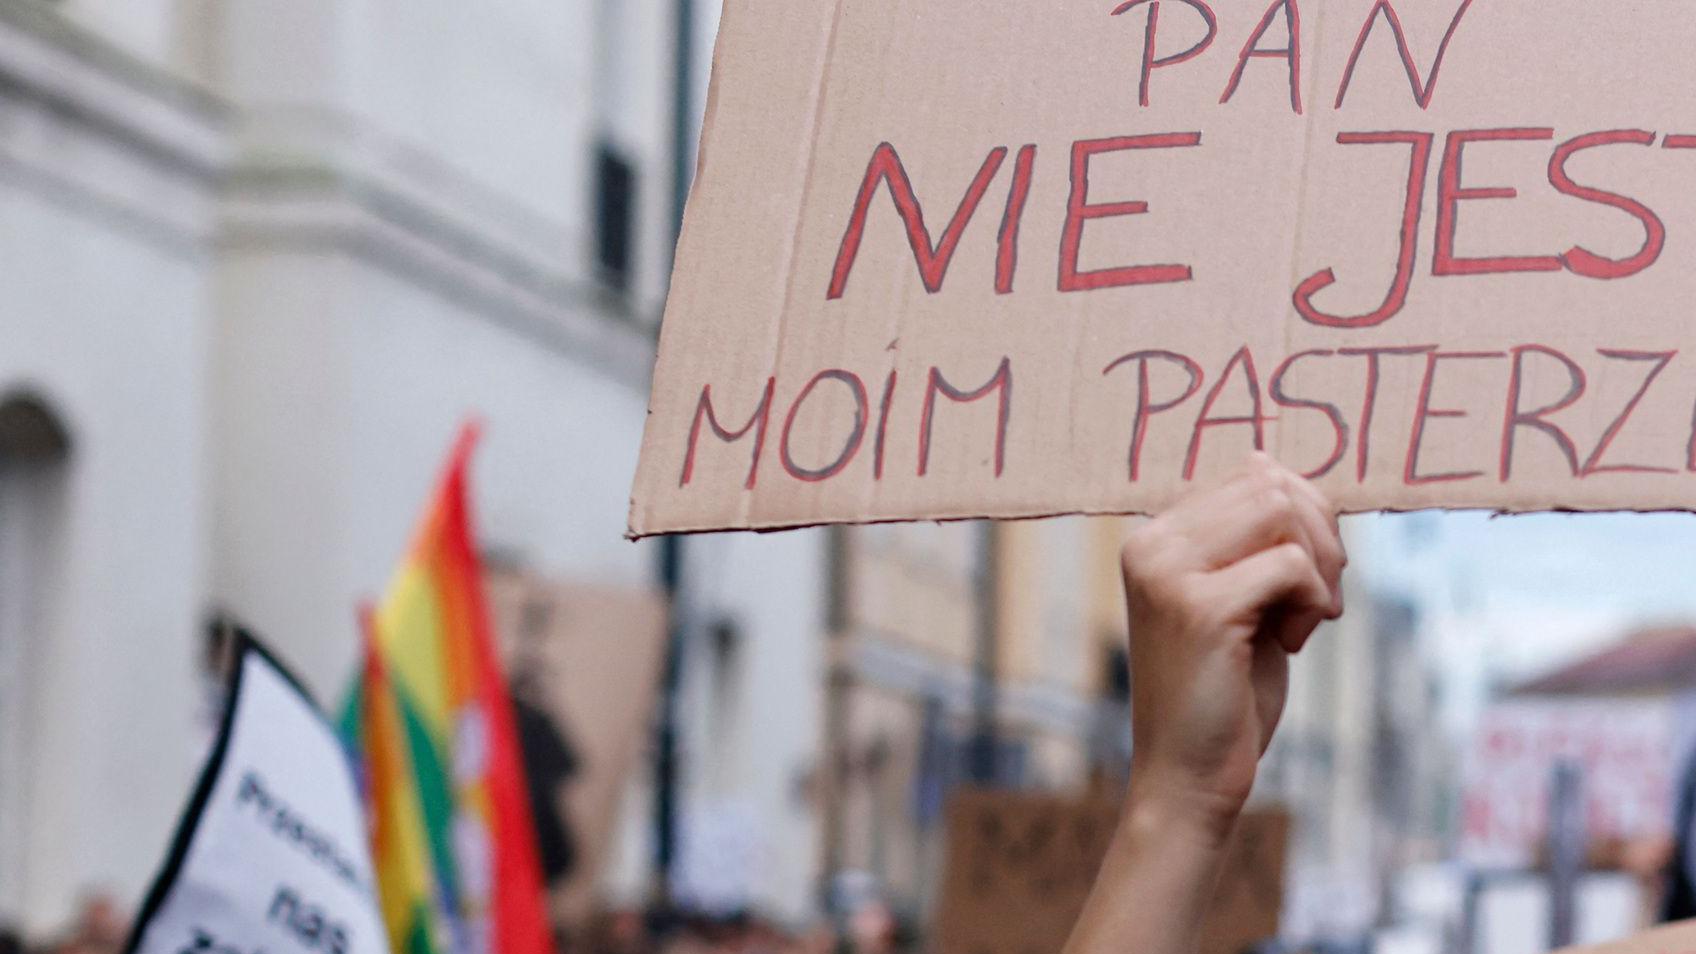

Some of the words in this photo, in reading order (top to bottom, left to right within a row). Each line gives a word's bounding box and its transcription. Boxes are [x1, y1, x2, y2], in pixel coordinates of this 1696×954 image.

[1111, 0, 1473, 114] PAN
[827, 131, 1202, 300] NIE
[680, 339, 1012, 490] MOIM
